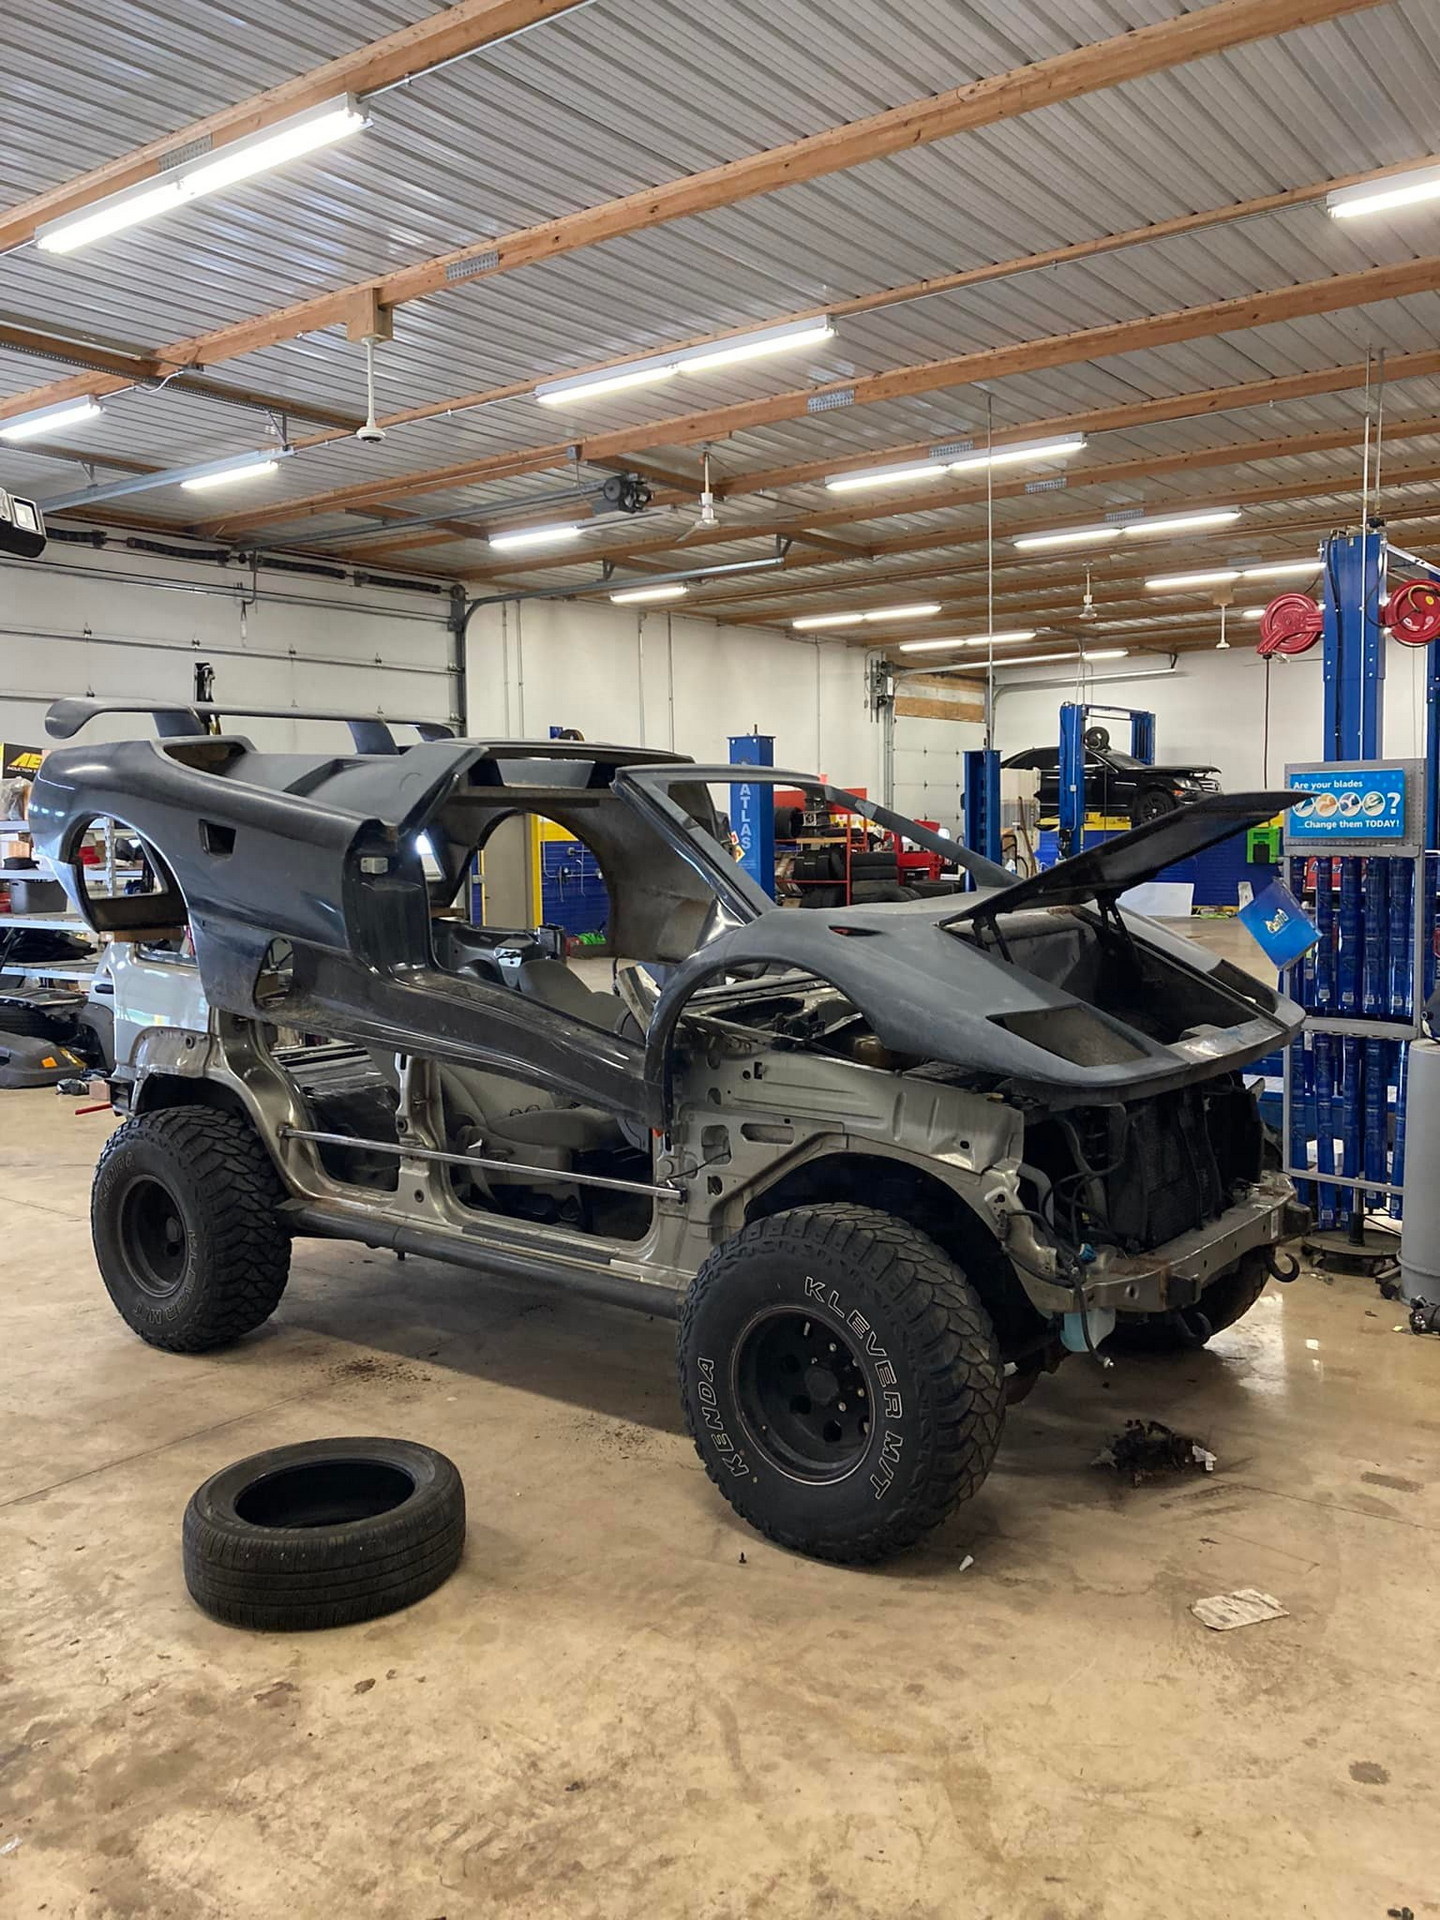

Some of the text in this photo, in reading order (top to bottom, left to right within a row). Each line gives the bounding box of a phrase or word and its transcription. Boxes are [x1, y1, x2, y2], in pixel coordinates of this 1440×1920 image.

[9, 752, 43, 769] AE
[1293, 780, 1364, 791] Are your blades
[740, 784, 752, 849] ATLAS
[1339, 819, 1363, 829] them
[1365, 819, 1400, 829] TODAY!
[803, 1275, 906, 1500] KLEVER M/T
[697, 1358, 750, 1478] KENDA
